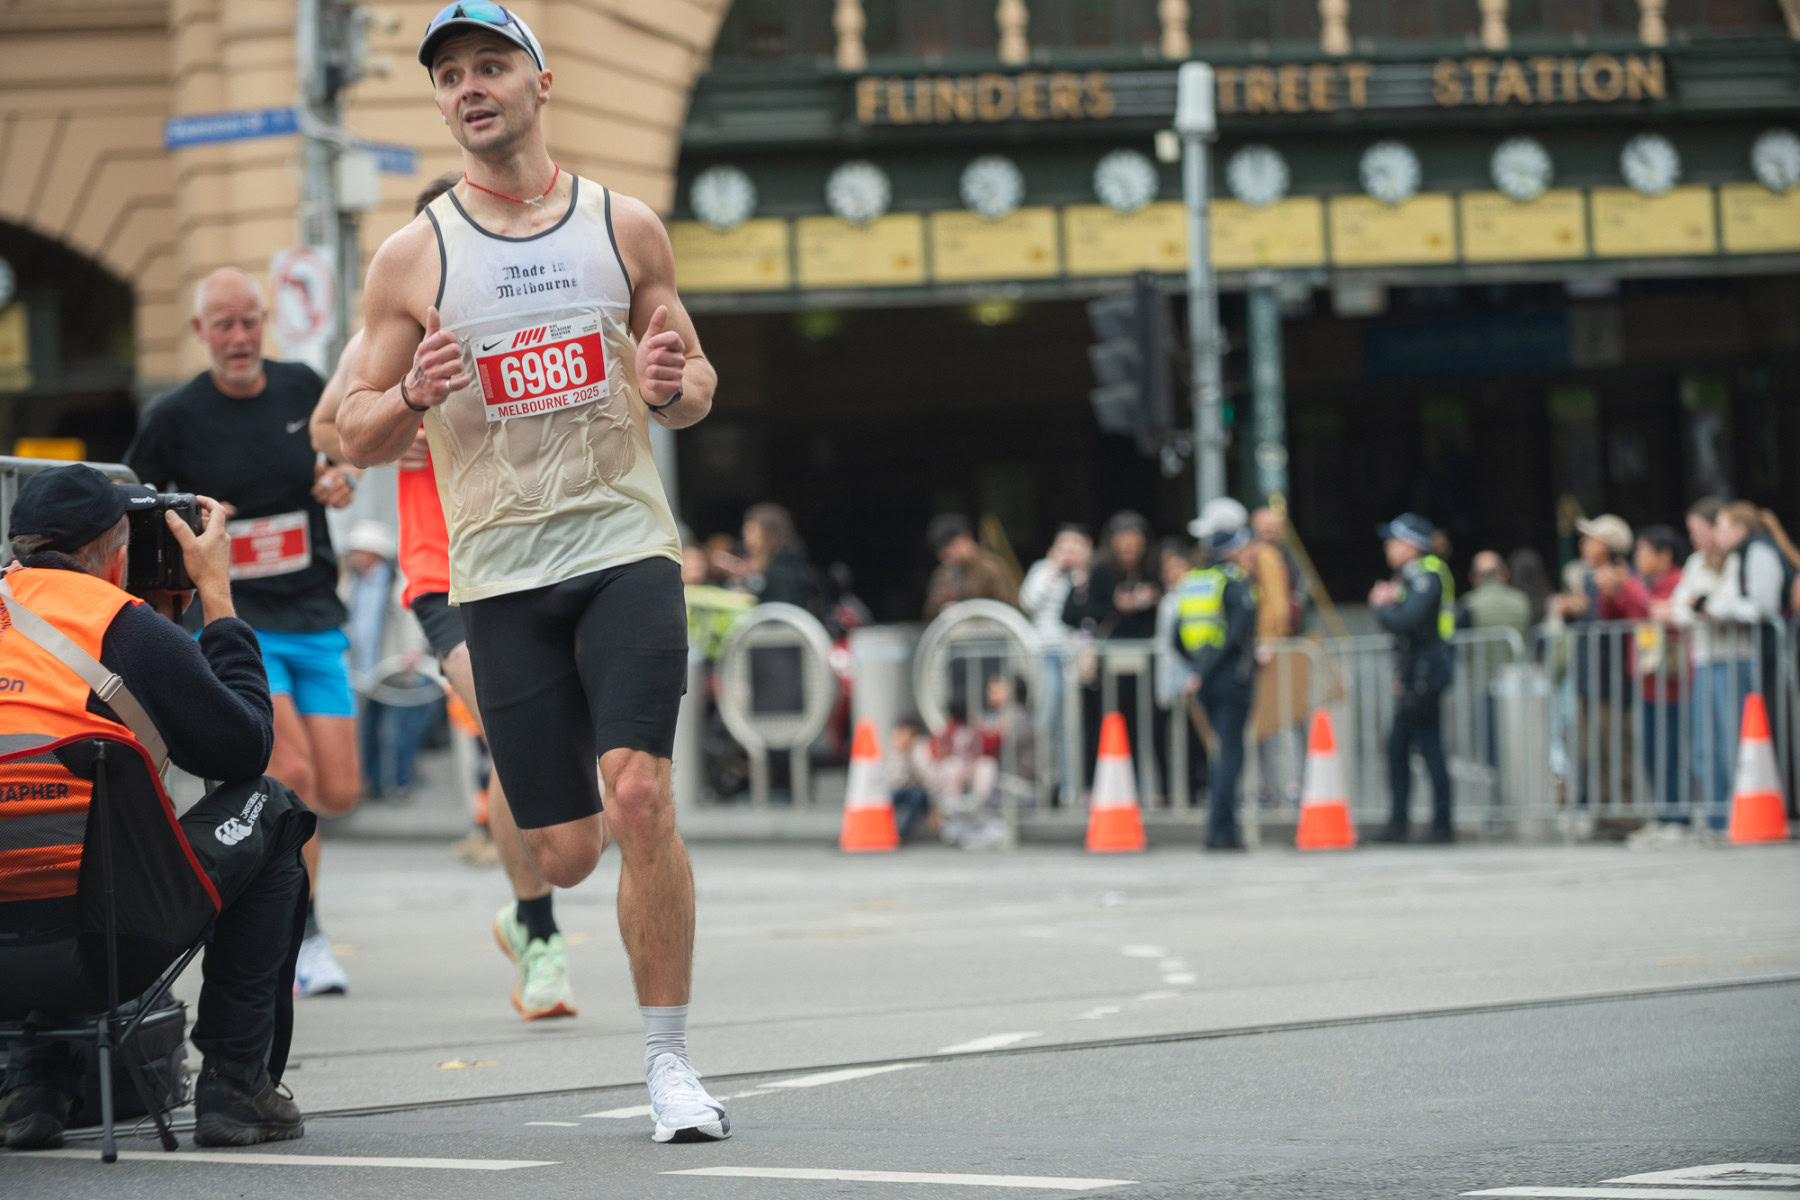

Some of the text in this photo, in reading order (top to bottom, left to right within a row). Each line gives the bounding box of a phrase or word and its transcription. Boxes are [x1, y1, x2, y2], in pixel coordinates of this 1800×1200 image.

[857, 54, 1666, 124] FLINDERS TREET STATION
[502, 264, 546, 280] Made
[496, 277, 578, 299] Melbourne
[500, 342, 588, 399] 6986
[498, 386, 600, 417] MELBOURNE 2025
[0, 783, 69, 802] APHER
